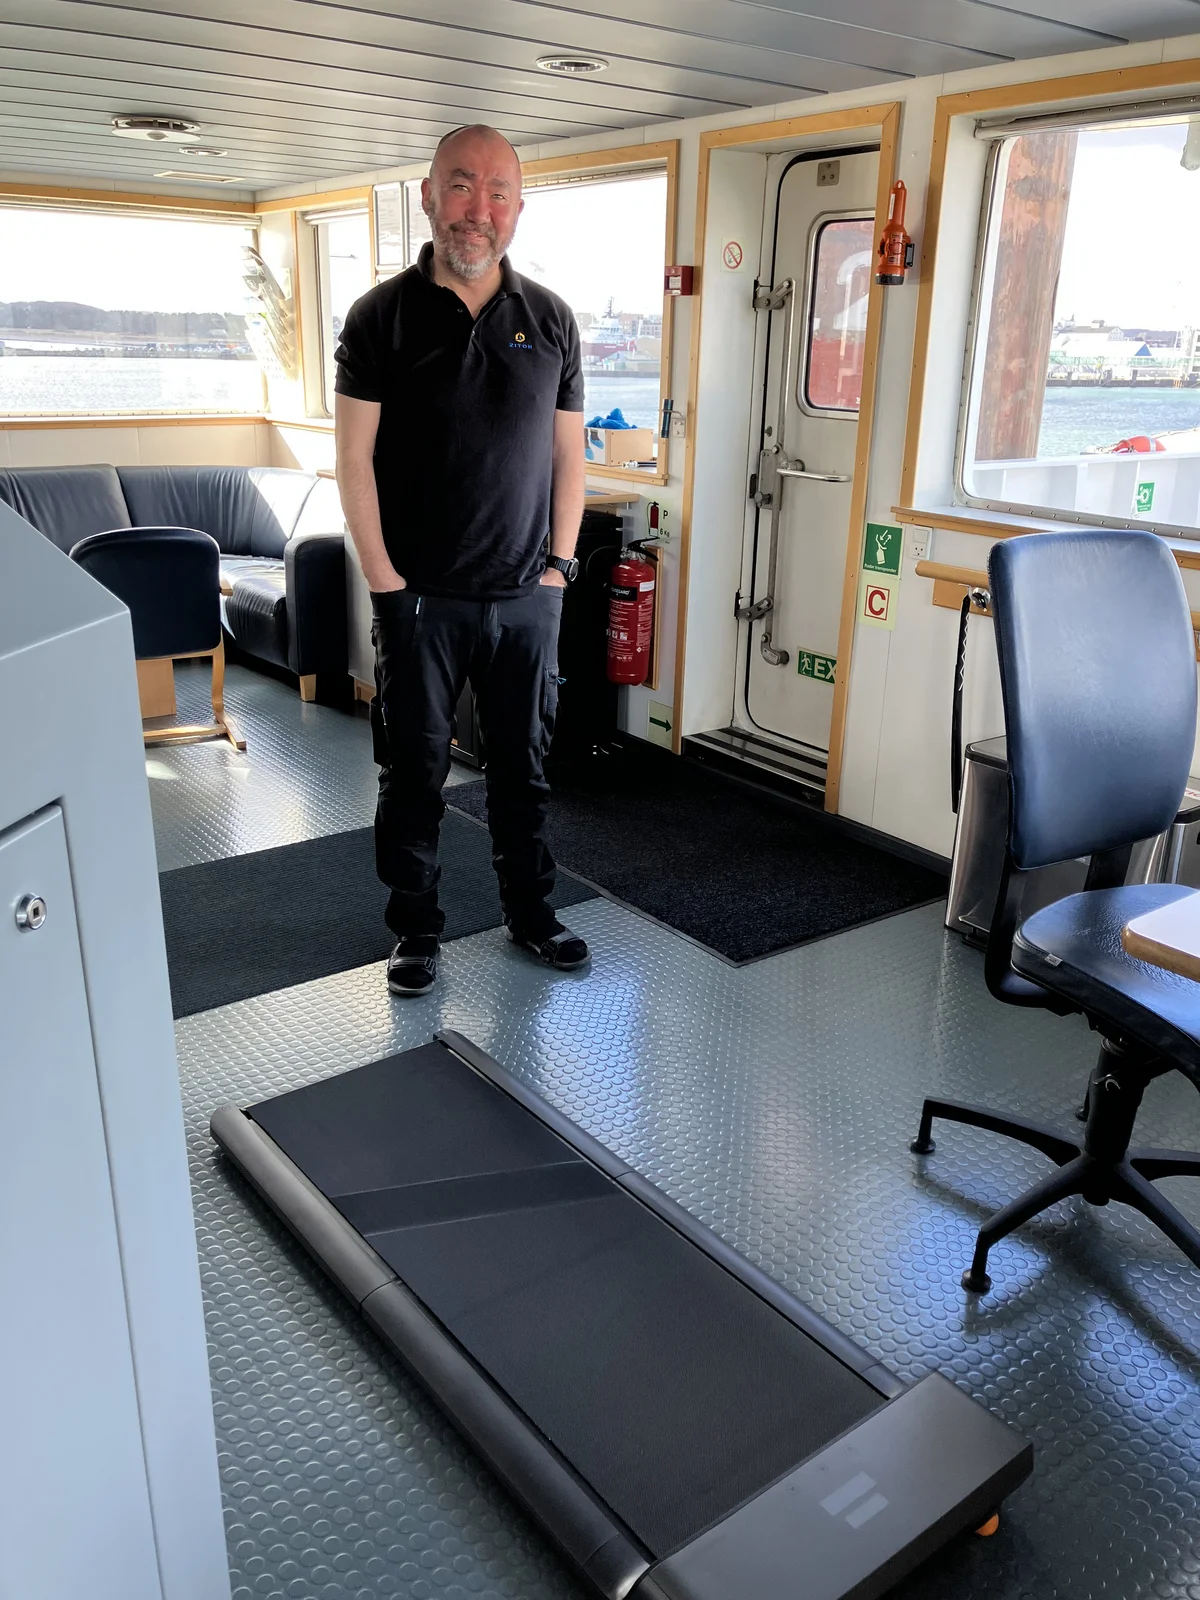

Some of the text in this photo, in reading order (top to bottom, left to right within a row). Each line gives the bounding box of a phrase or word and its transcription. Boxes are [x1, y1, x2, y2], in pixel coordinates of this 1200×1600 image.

[508, 342, 533, 350] ZITON
[662, 509, 669, 520] P
[659, 528, 664, 536] 6
[868, 589, 887, 616] C
[813, 657, 838, 680] EX
